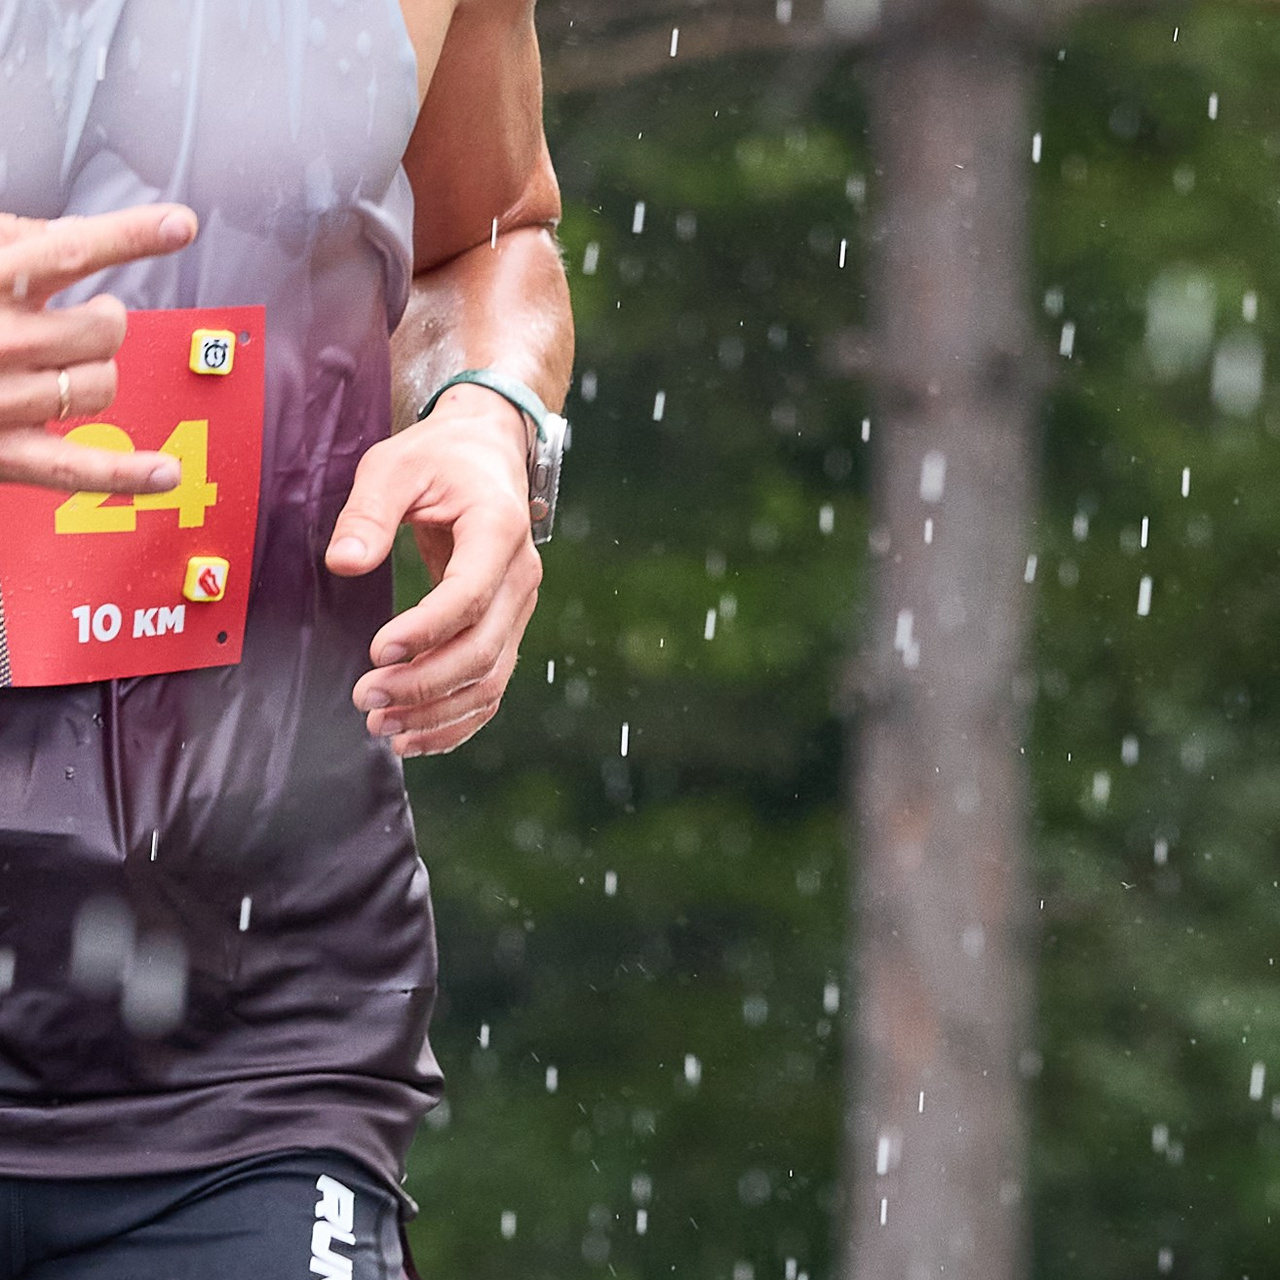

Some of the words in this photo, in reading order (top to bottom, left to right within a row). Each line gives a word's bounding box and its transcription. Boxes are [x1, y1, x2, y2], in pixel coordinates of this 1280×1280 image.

[55, 419, 218, 535] 24
[72, 604, 122, 643] 10
[132, 605, 186, 638] КМ
